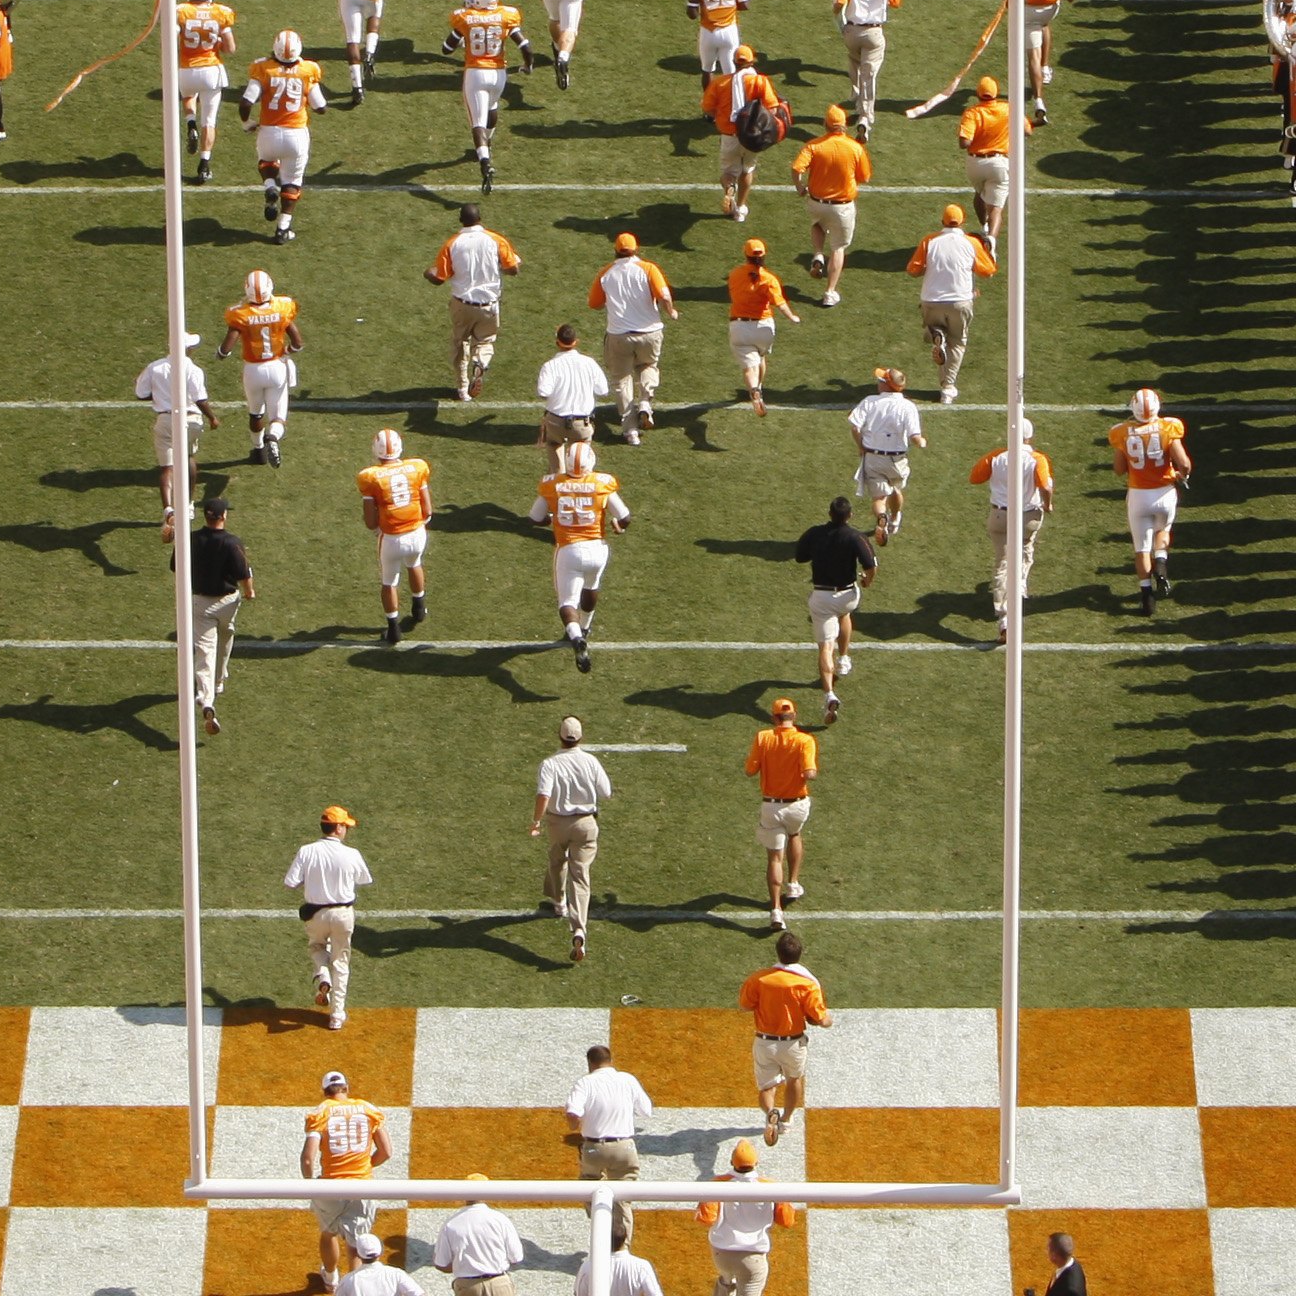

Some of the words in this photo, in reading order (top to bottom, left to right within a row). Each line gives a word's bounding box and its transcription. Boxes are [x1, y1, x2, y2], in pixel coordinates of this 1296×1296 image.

[183, 19, 220, 50] 53
[469, 25, 504, 57] 86
[268, 76, 304, 112] 79
[247, 313, 281, 325] WARREN
[261, 326, 275, 359] 1
[1126, 434, 1164, 469] 94
